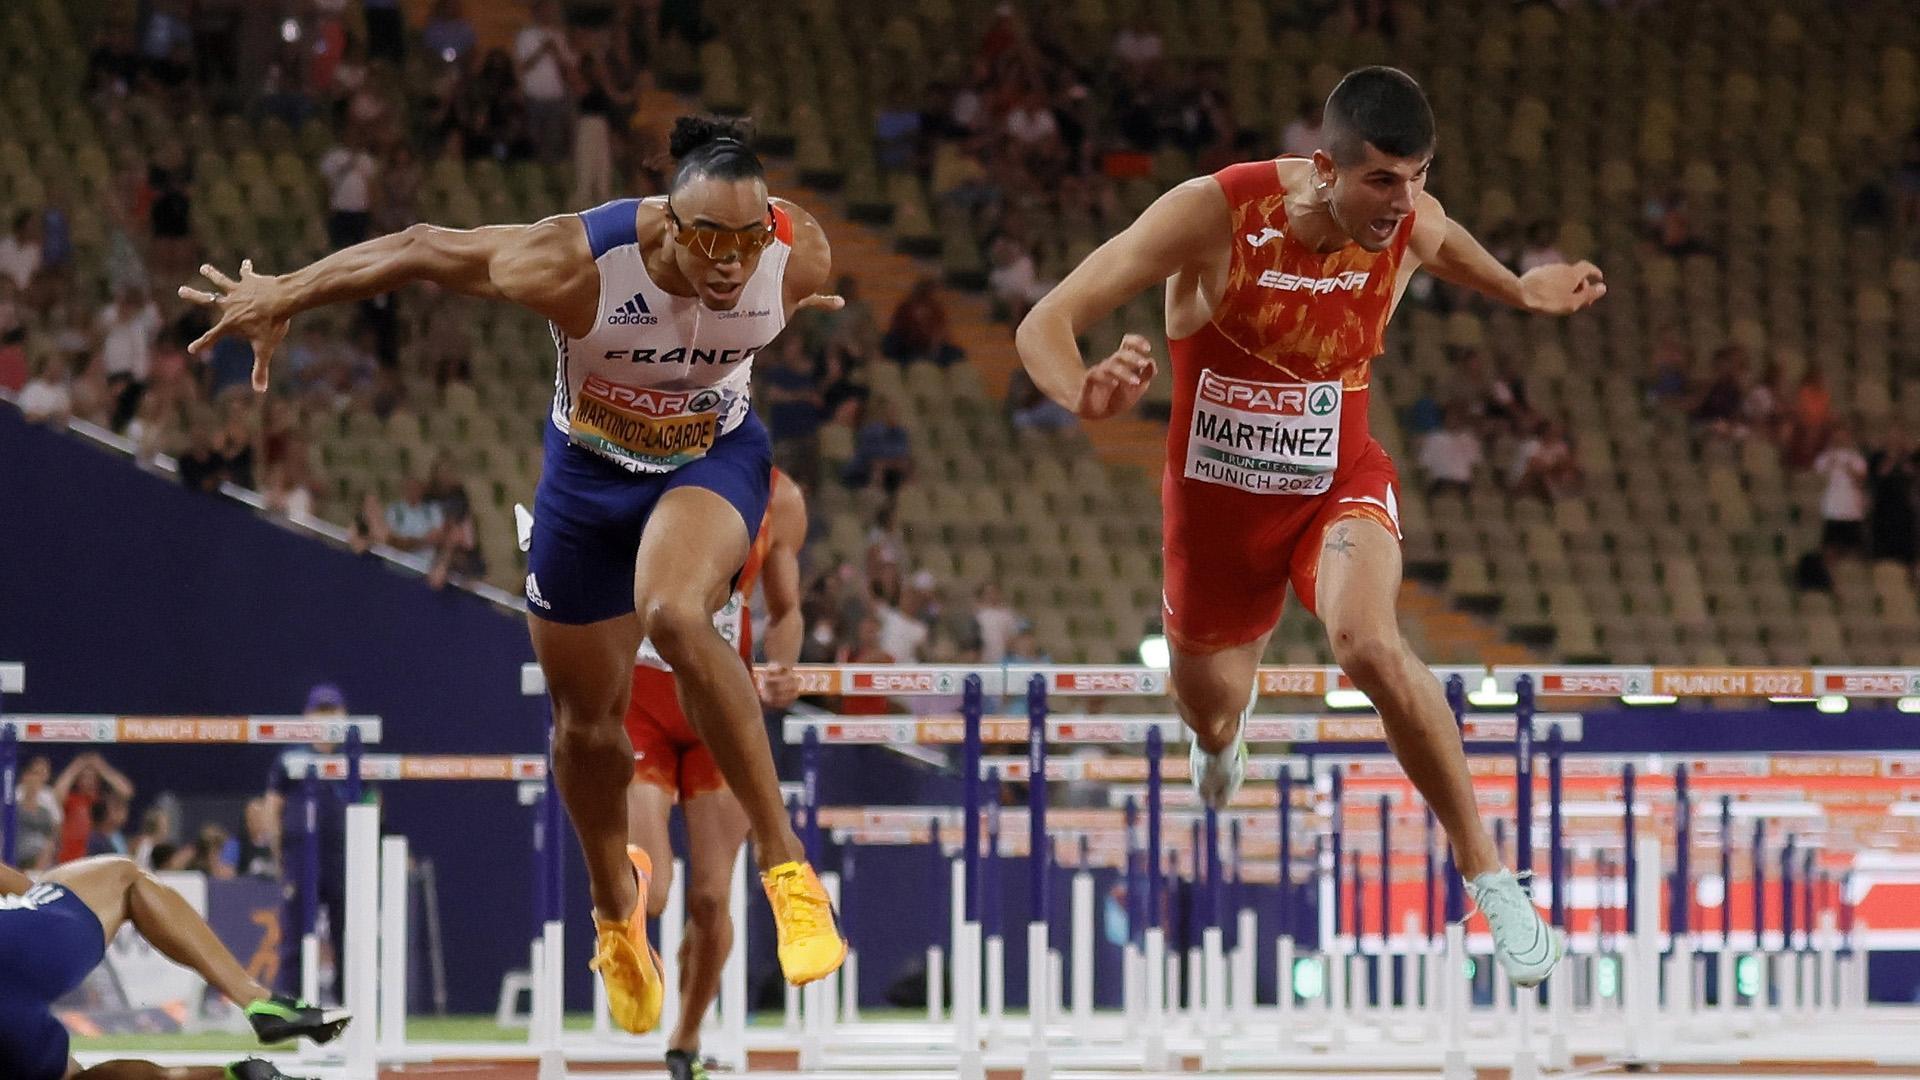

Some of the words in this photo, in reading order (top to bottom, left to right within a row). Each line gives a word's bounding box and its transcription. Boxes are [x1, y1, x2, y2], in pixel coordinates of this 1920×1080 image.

[1257, 269, 1370, 295] ESPAÑA
[608, 313, 658, 325] adidas
[586, 379, 685, 415] SPAR
[1203, 376, 1304, 412] SPAR
[574, 401, 711, 450] MARTINOT-LAGARDE
[1195, 410, 1334, 457] MARTÍNEZ
[1195, 460, 1271, 489] MUNICH
[1278, 475, 1325, 491] 2022
[1228, 455, 1255, 468] RUN
[1257, 460, 1299, 473] CLEAN
[1663, 675, 1747, 693] MUNICH
